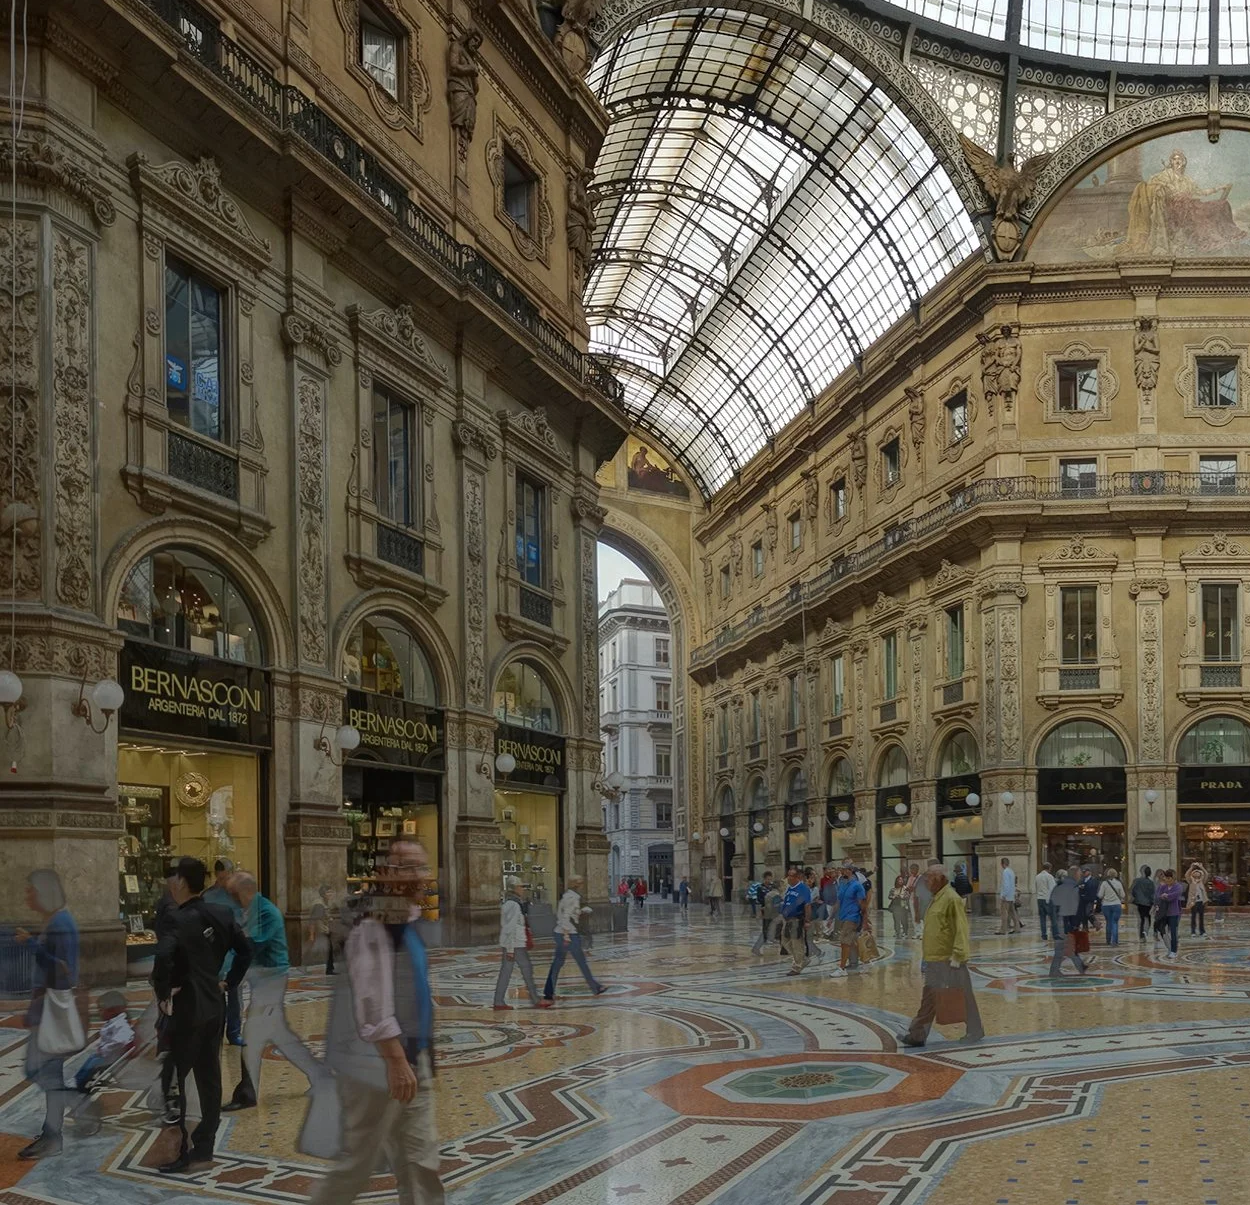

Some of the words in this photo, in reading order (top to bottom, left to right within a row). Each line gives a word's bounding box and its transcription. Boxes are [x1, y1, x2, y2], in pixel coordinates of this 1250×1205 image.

[131, 665, 260, 712] BERNASCONI
[148, 697, 206, 719] ARGENTERIA
[208, 707, 226, 722] DAL
[228, 711, 248, 725] 1872
[349, 708, 437, 743] BERNASCONI
[361, 733, 401, 749] ARGENTERIA
[401, 740, 414, 752] DAL
[414, 742, 429, 754] 1872
[498, 739, 561, 765] BERNASCONI
[1060, 782, 1103, 790] PRADA
[1200, 781, 1243, 789] PRADA
